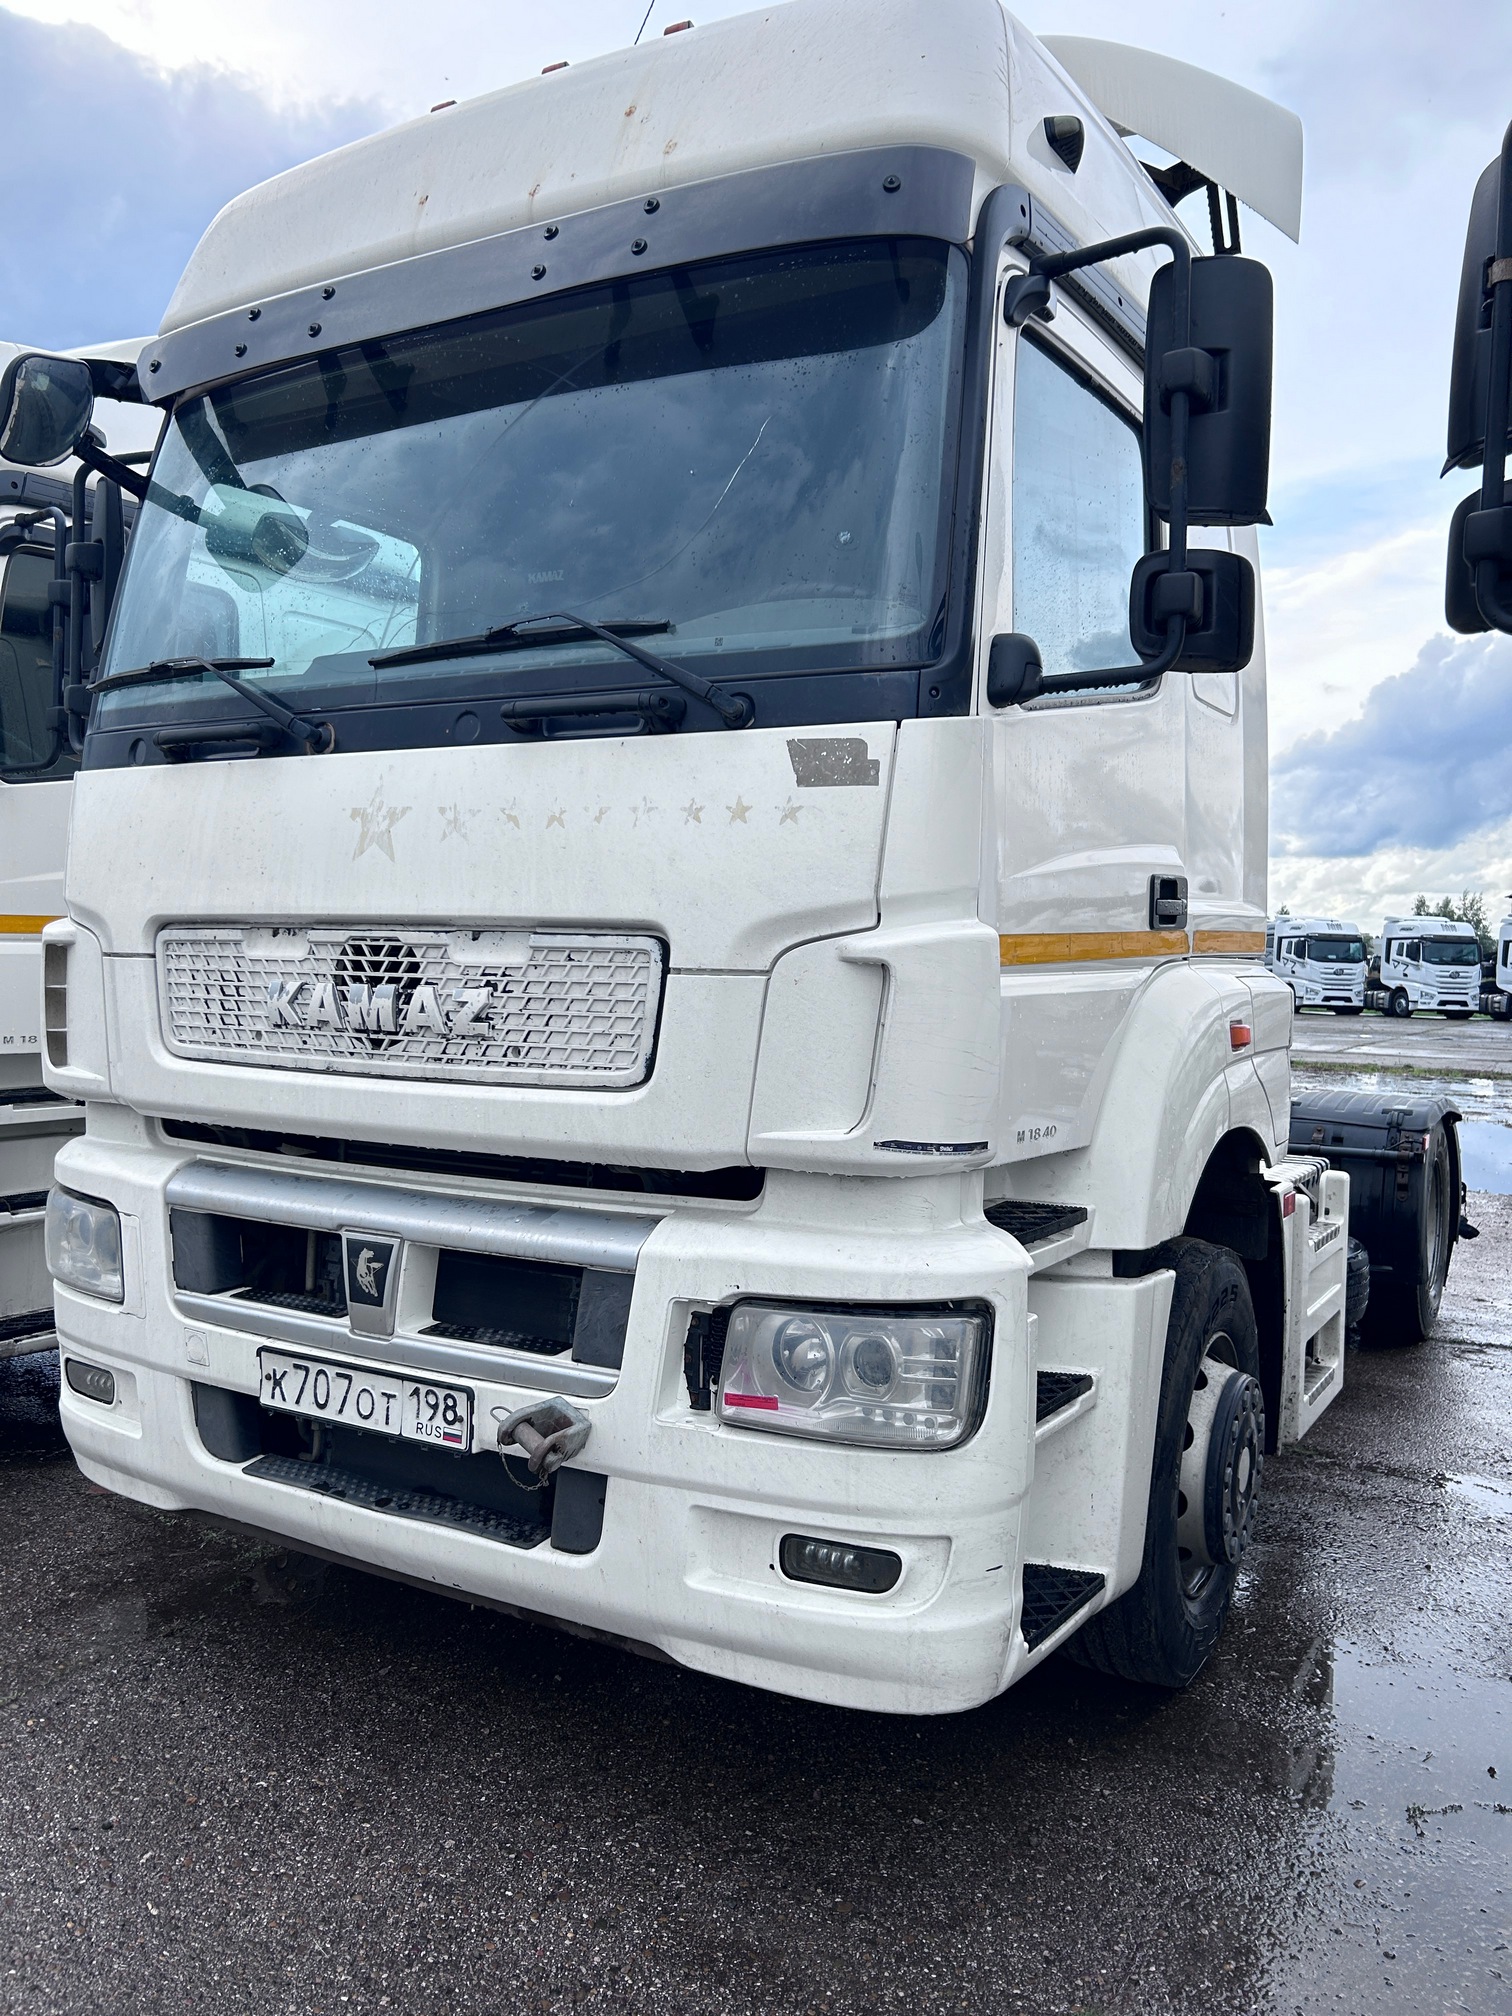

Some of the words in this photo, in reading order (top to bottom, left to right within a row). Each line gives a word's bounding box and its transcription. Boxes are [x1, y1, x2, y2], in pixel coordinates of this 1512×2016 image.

[267, 979, 493, 1037] KAMAZ
[3, 1035, 14, 1045] M
[1016, 1130, 1026, 1143] M
[408, 1385, 458, 1426] 198
[415, 1421, 443, 1439] RUS
